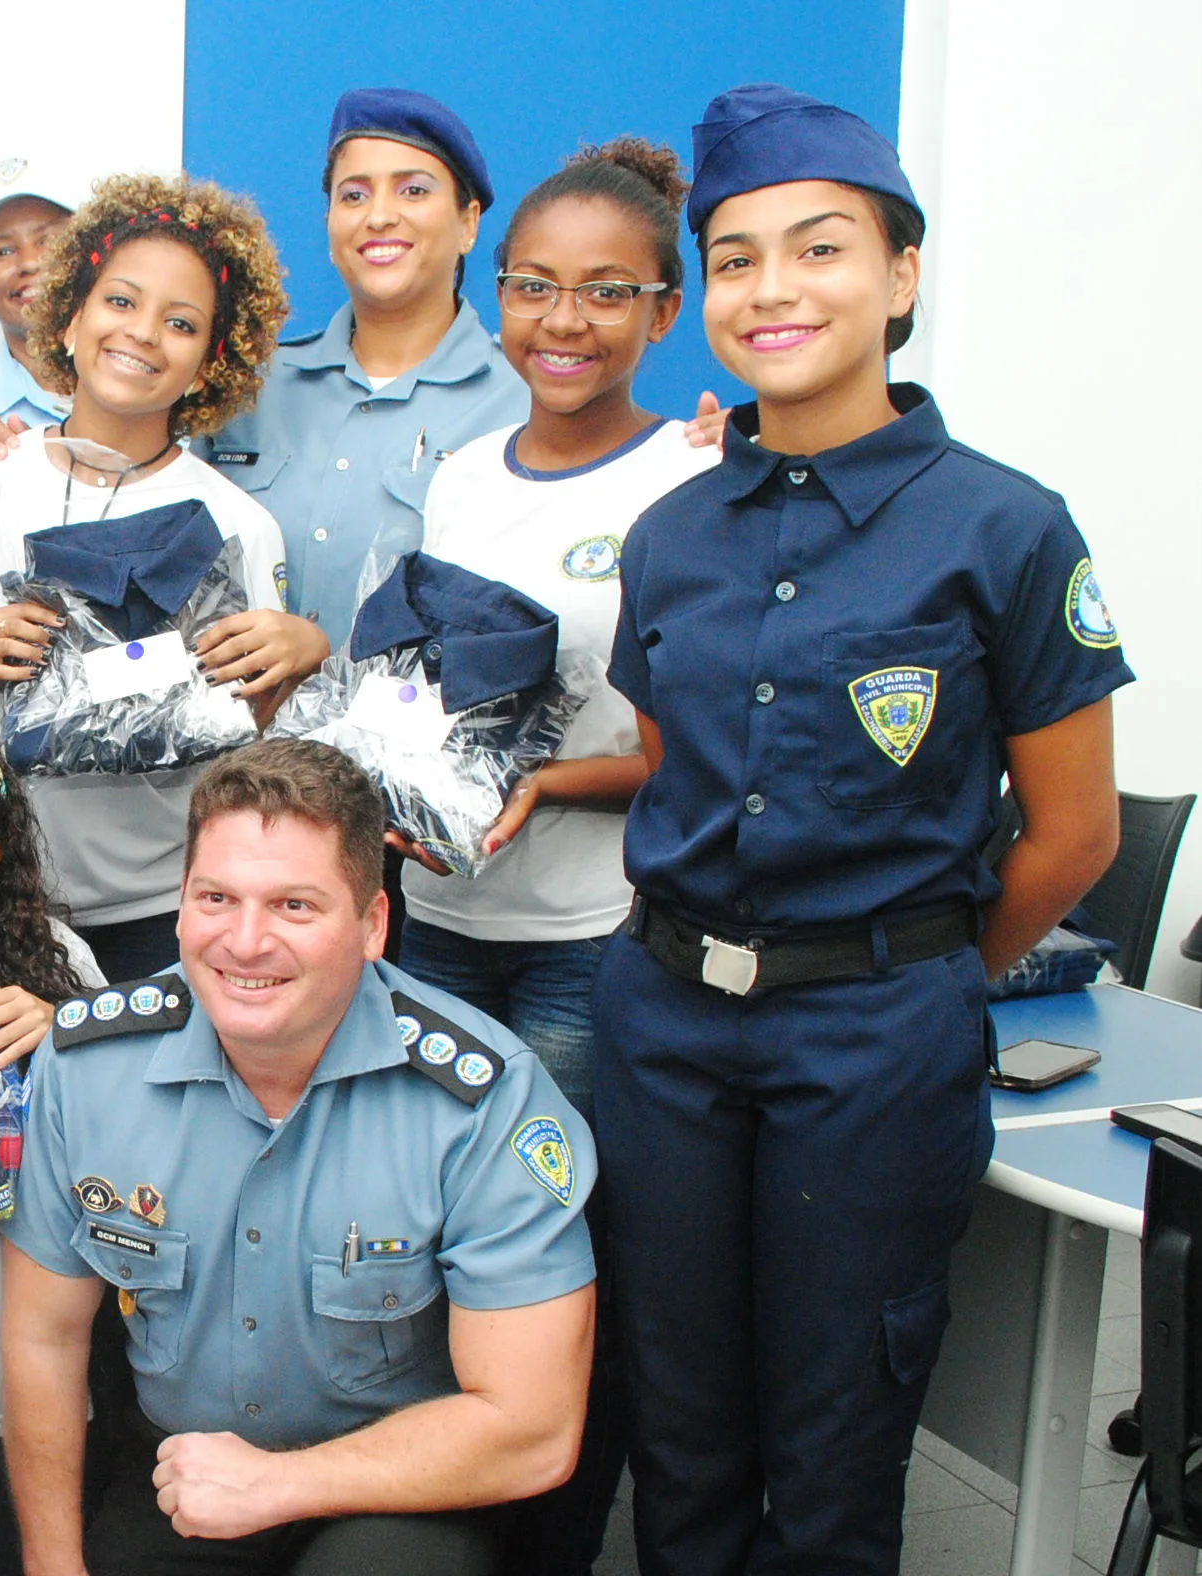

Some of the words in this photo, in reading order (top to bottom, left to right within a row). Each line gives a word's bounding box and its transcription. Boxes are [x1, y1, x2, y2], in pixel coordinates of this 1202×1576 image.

[865, 672, 921, 689] GUARDA
[858, 688, 882, 704] CIVIL
[883, 683, 932, 695] MUNICIPAL
[860, 704, 892, 751] CACHOEIRO
[894, 748, 909, 757] DE
[908, 696, 932, 746] ITAPEMIRIM
[118, 1236, 151, 1252] MENON
